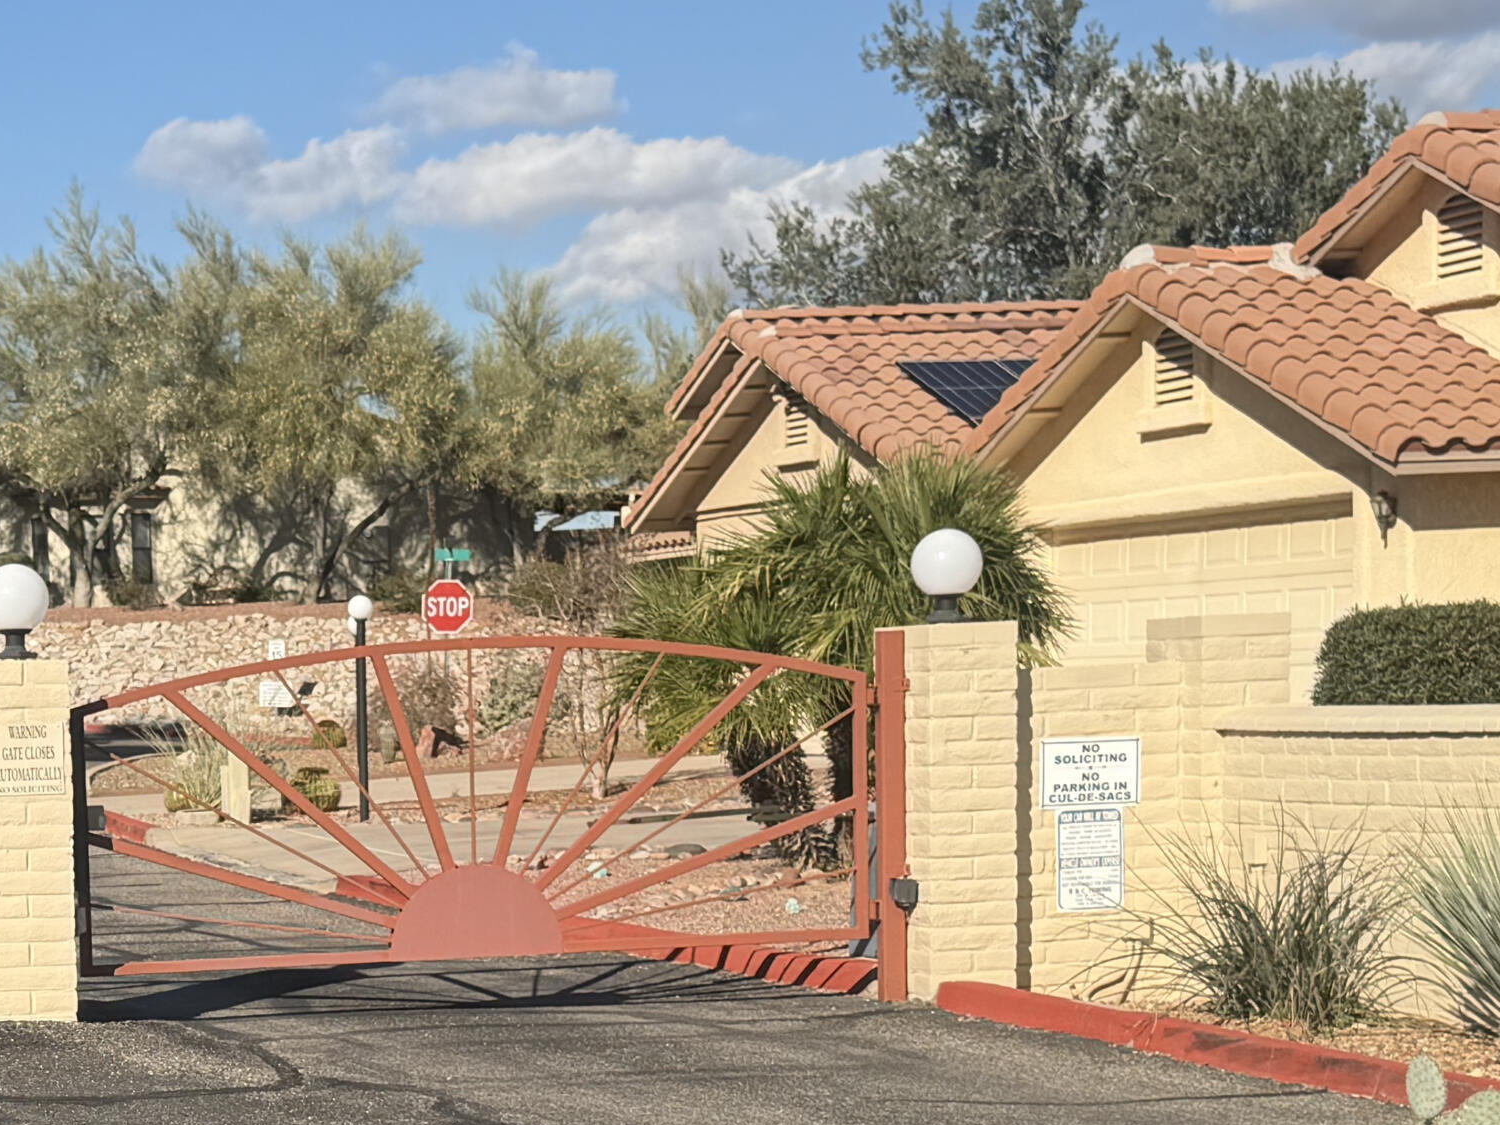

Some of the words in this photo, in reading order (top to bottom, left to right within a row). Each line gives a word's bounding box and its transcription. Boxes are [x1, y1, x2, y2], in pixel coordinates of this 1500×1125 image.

[427, 596, 469, 617] STOP
[8, 725, 47, 739] WARNING
[2, 746, 24, 760] GATE
[25, 745, 55, 760] CLOSES
[1082, 744, 1100, 753] NO
[1054, 753, 1127, 765] SOLICITING
[1081, 772, 1100, 781] NO
[12, 784, 63, 794] SOLICITING
[1053, 782, 1110, 793] PARKING
[1114, 781, 1128, 790] IN
[1048, 791, 1132, 803] CUL-DE-SACS
